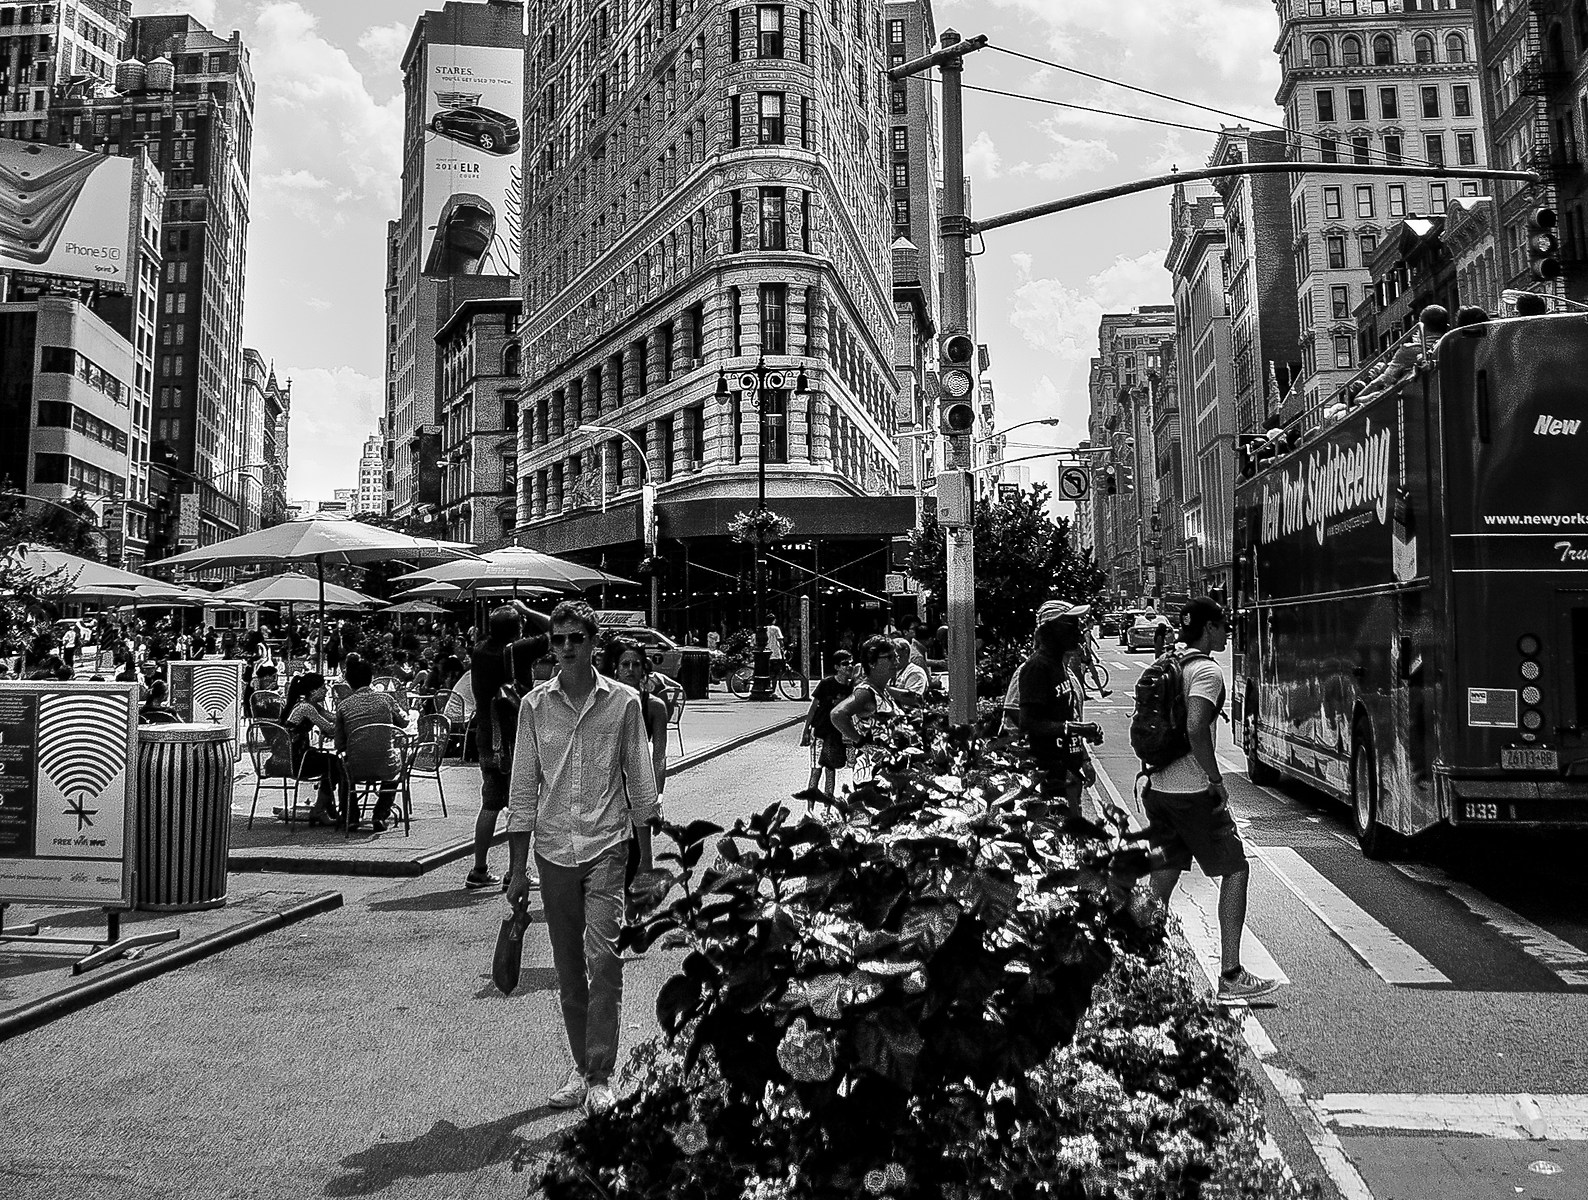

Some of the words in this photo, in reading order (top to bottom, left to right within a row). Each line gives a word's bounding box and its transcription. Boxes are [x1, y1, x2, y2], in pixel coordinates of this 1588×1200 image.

[435, 66, 474, 76] STARES.
[460, 163, 480, 173] ELR
[65, 242, 99, 258] iPhone
[1533, 414, 1582, 436] New
[1262, 484, 1281, 545] New
[1281, 460, 1305, 536] York
[1305, 416, 1391, 546] Sightseeing
[1553, 541, 1588, 562] Tru
